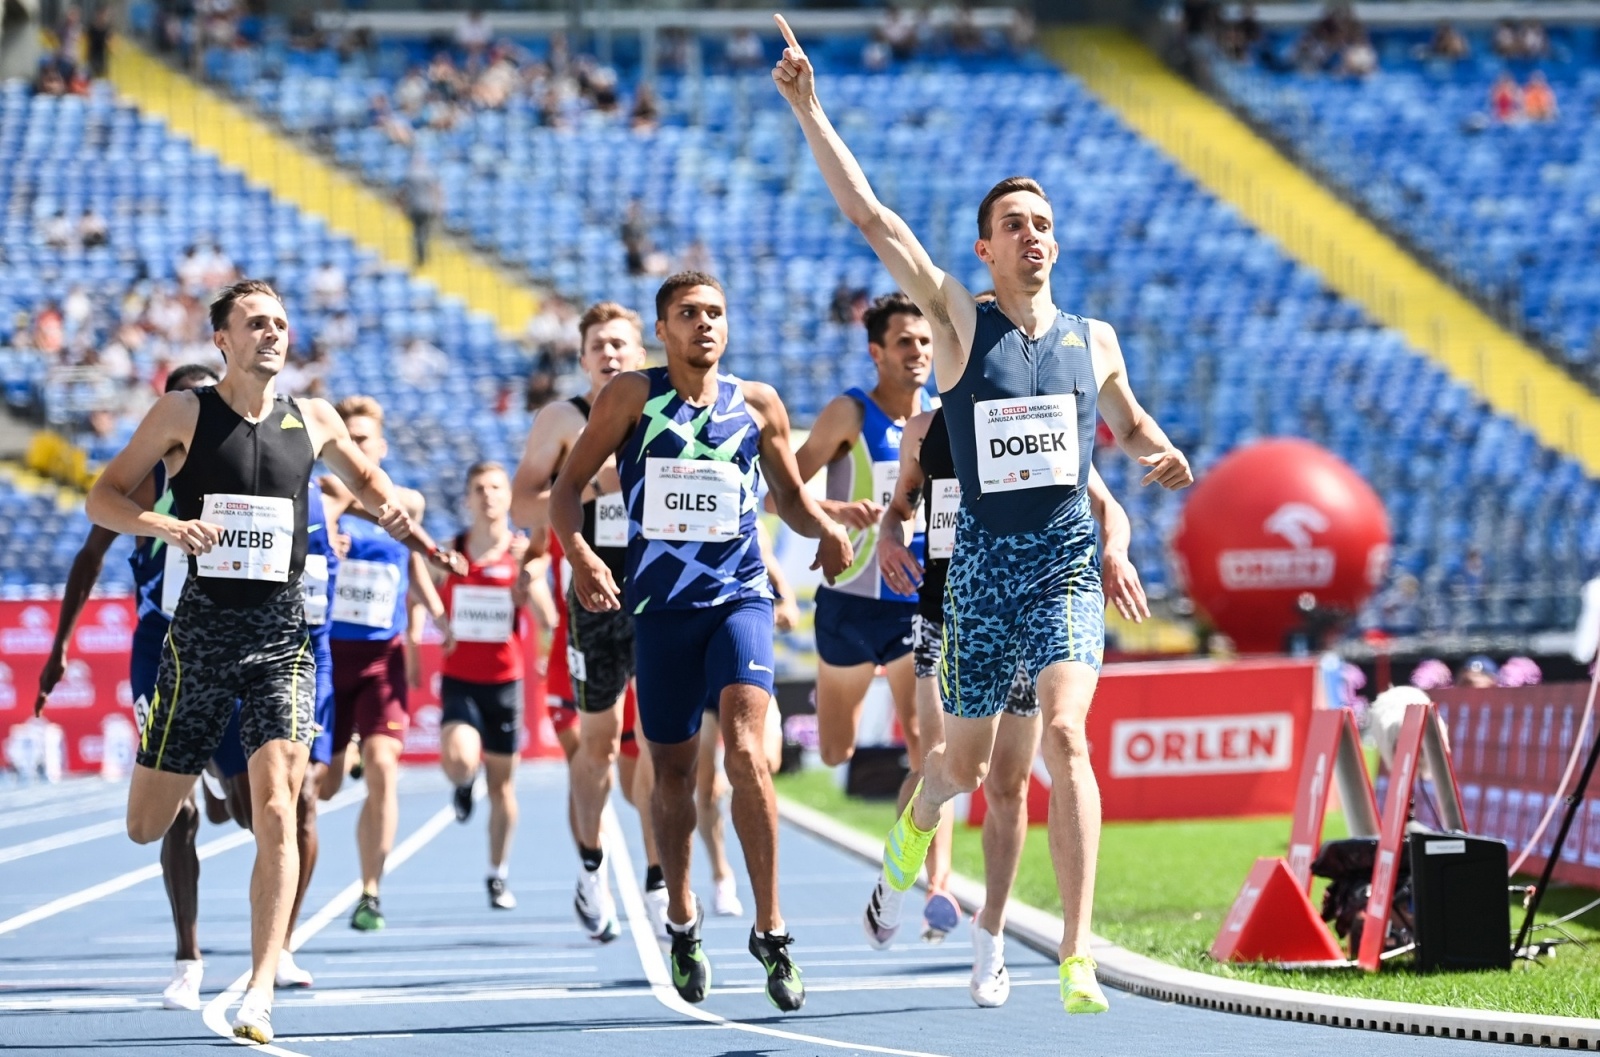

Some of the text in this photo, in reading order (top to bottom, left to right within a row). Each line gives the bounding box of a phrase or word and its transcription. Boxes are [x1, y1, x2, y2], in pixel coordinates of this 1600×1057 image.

[987, 416, 1014, 424] JANUSZA
[1003, 406, 1026, 415] ORLEN
[989, 432, 1067, 459] DOBEK
[665, 492, 717, 512] GILES
[218, 529, 274, 549] WEBB
[1126, 727, 1278, 763] ORLEN
